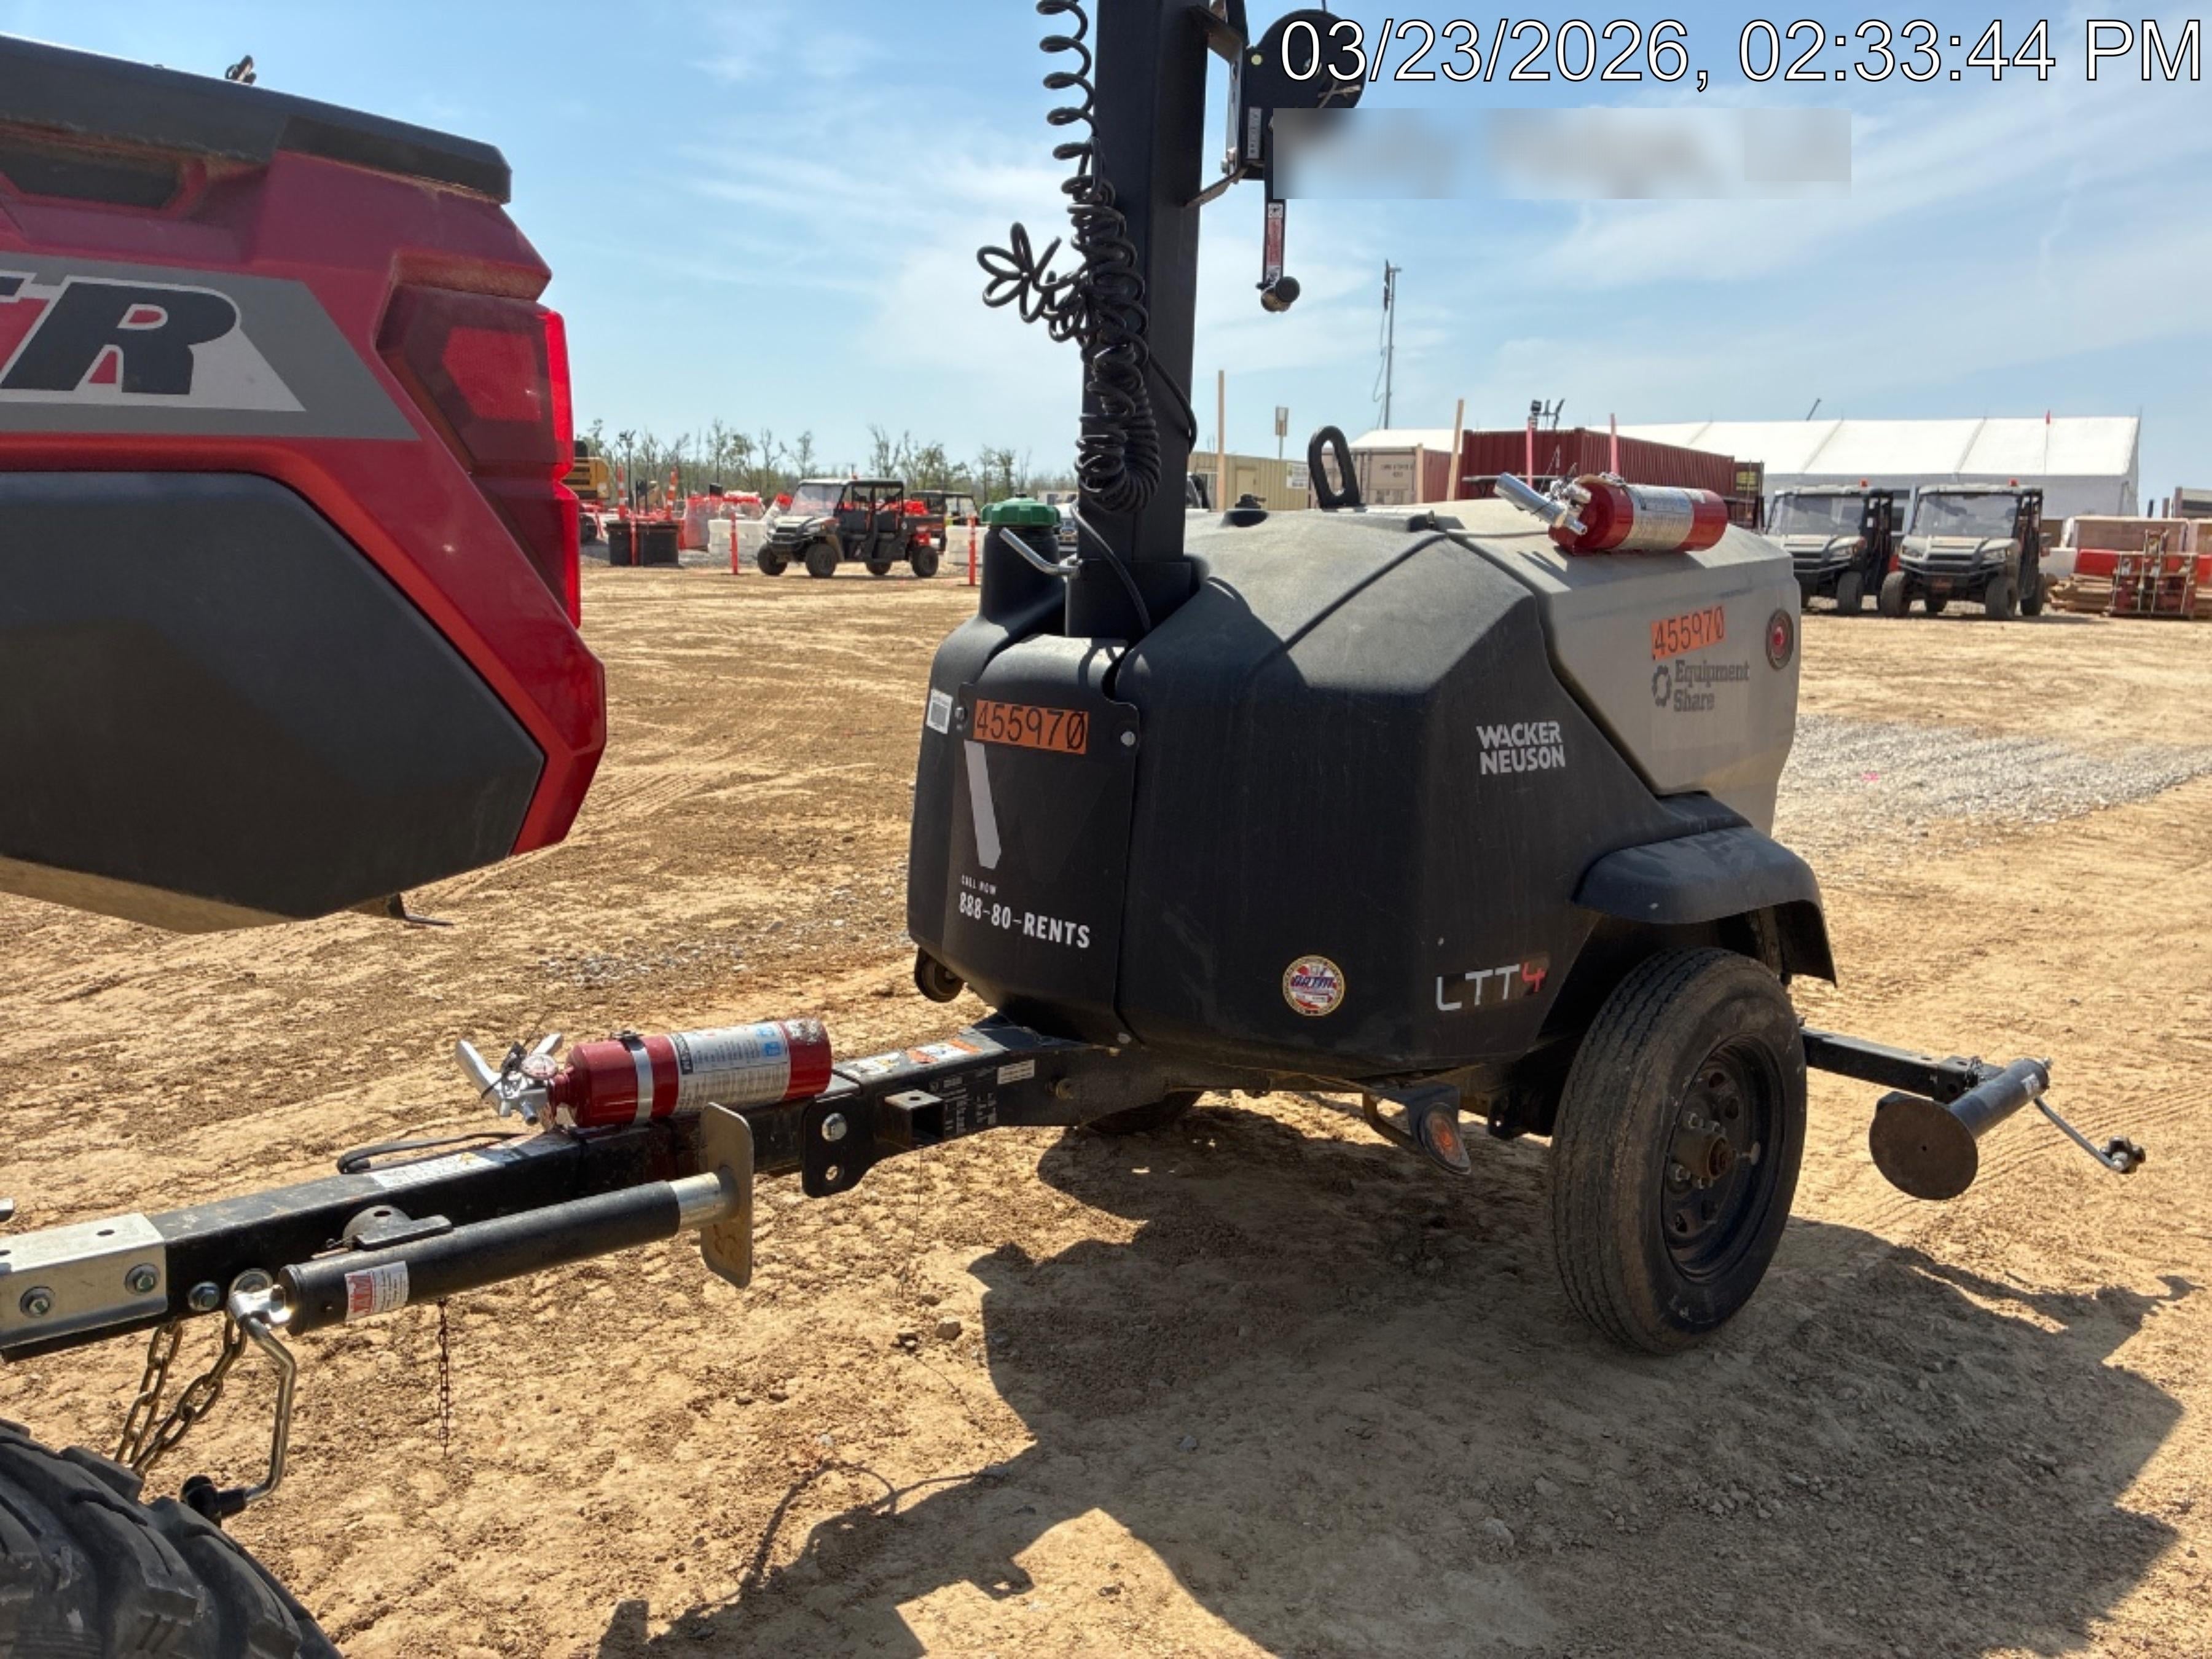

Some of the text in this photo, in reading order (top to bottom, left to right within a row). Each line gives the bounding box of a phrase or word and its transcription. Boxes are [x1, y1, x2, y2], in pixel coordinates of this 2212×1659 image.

[0, 273, 241, 396] R
[1654, 605, 1724, 655] 455970
[1674, 659, 1751, 688] Equipment
[1673, 689, 1715, 712] Share
[976, 702, 1085, 750] 455970
[1476, 721, 1563, 749] WACKER
[1480, 745, 1566, 775] NEUSON
[962, 874, 997, 895] CALL NOW
[959, 892, 1090, 948] 888-80-RENTS
[1436, 962, 1546, 1011] LTT4
